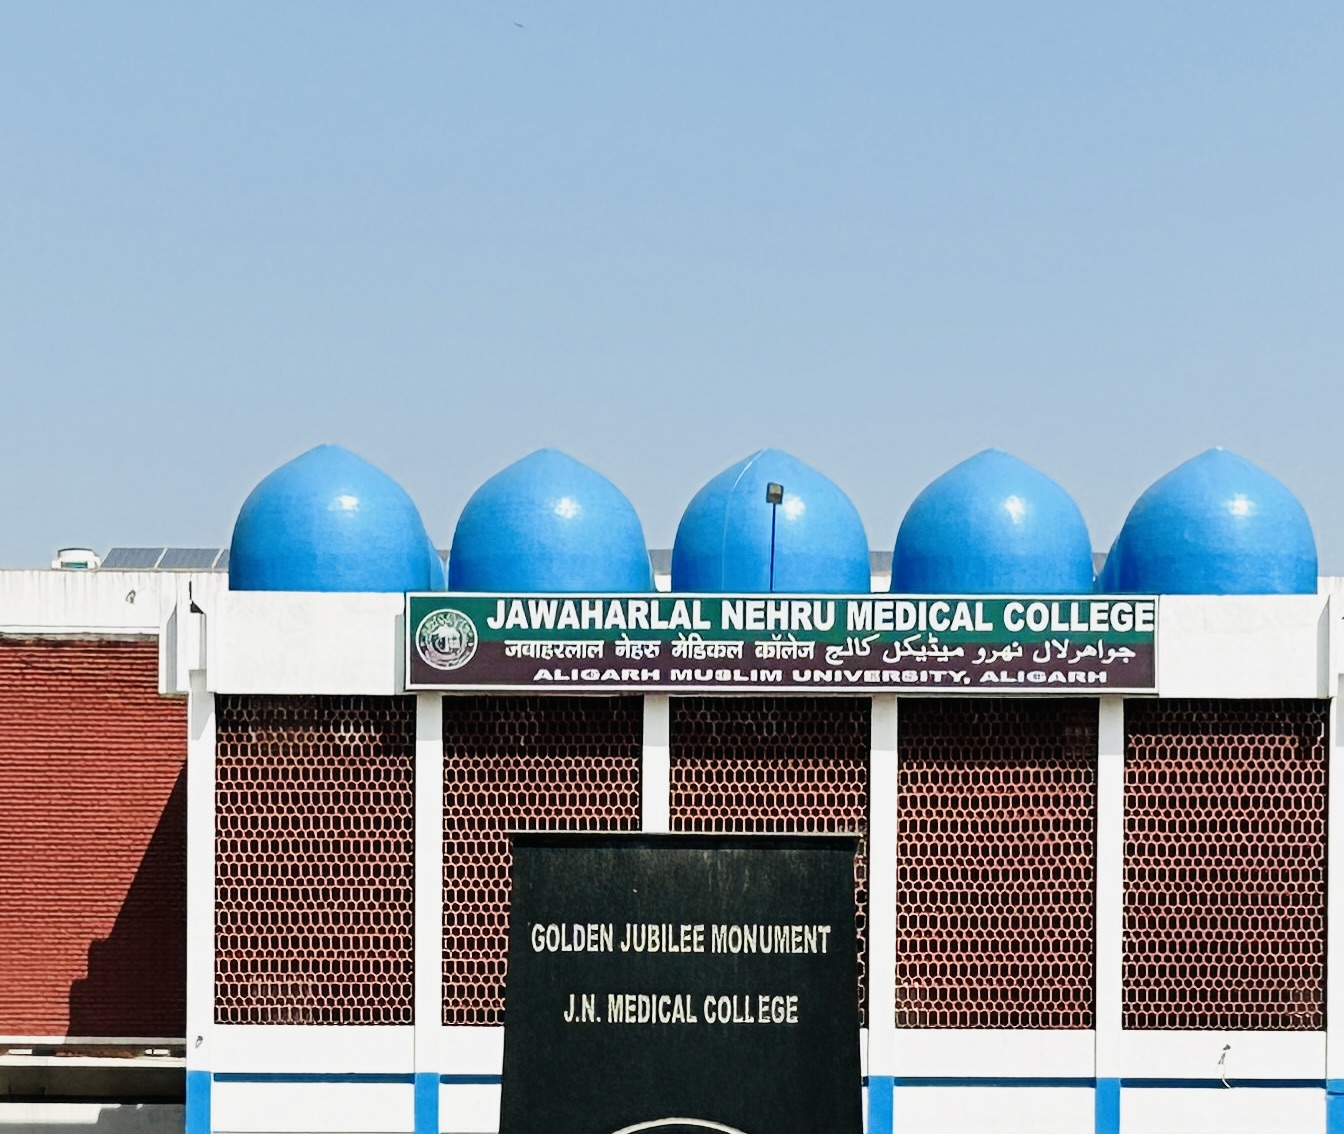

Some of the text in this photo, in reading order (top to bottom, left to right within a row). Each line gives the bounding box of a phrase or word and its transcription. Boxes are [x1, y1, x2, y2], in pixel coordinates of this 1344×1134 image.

[486, 599, 1156, 633] JAWAHARLAL NEHRU MEDICAL COLLEGE
[503, 638, 605, 660] जवाहरलाल
[671, 632, 745, 660] मेडिकल
[754, 632, 815, 660] कॉलेज
[533, 668, 1108, 685] ALIGARH MUSLIM UNIVERSITY, ALIGARH
[531, 922, 832, 954] GOLDEN JUBILEE MONUMENT
[563, 993, 799, 1025] J.N. MEDICAL COLLEGE
